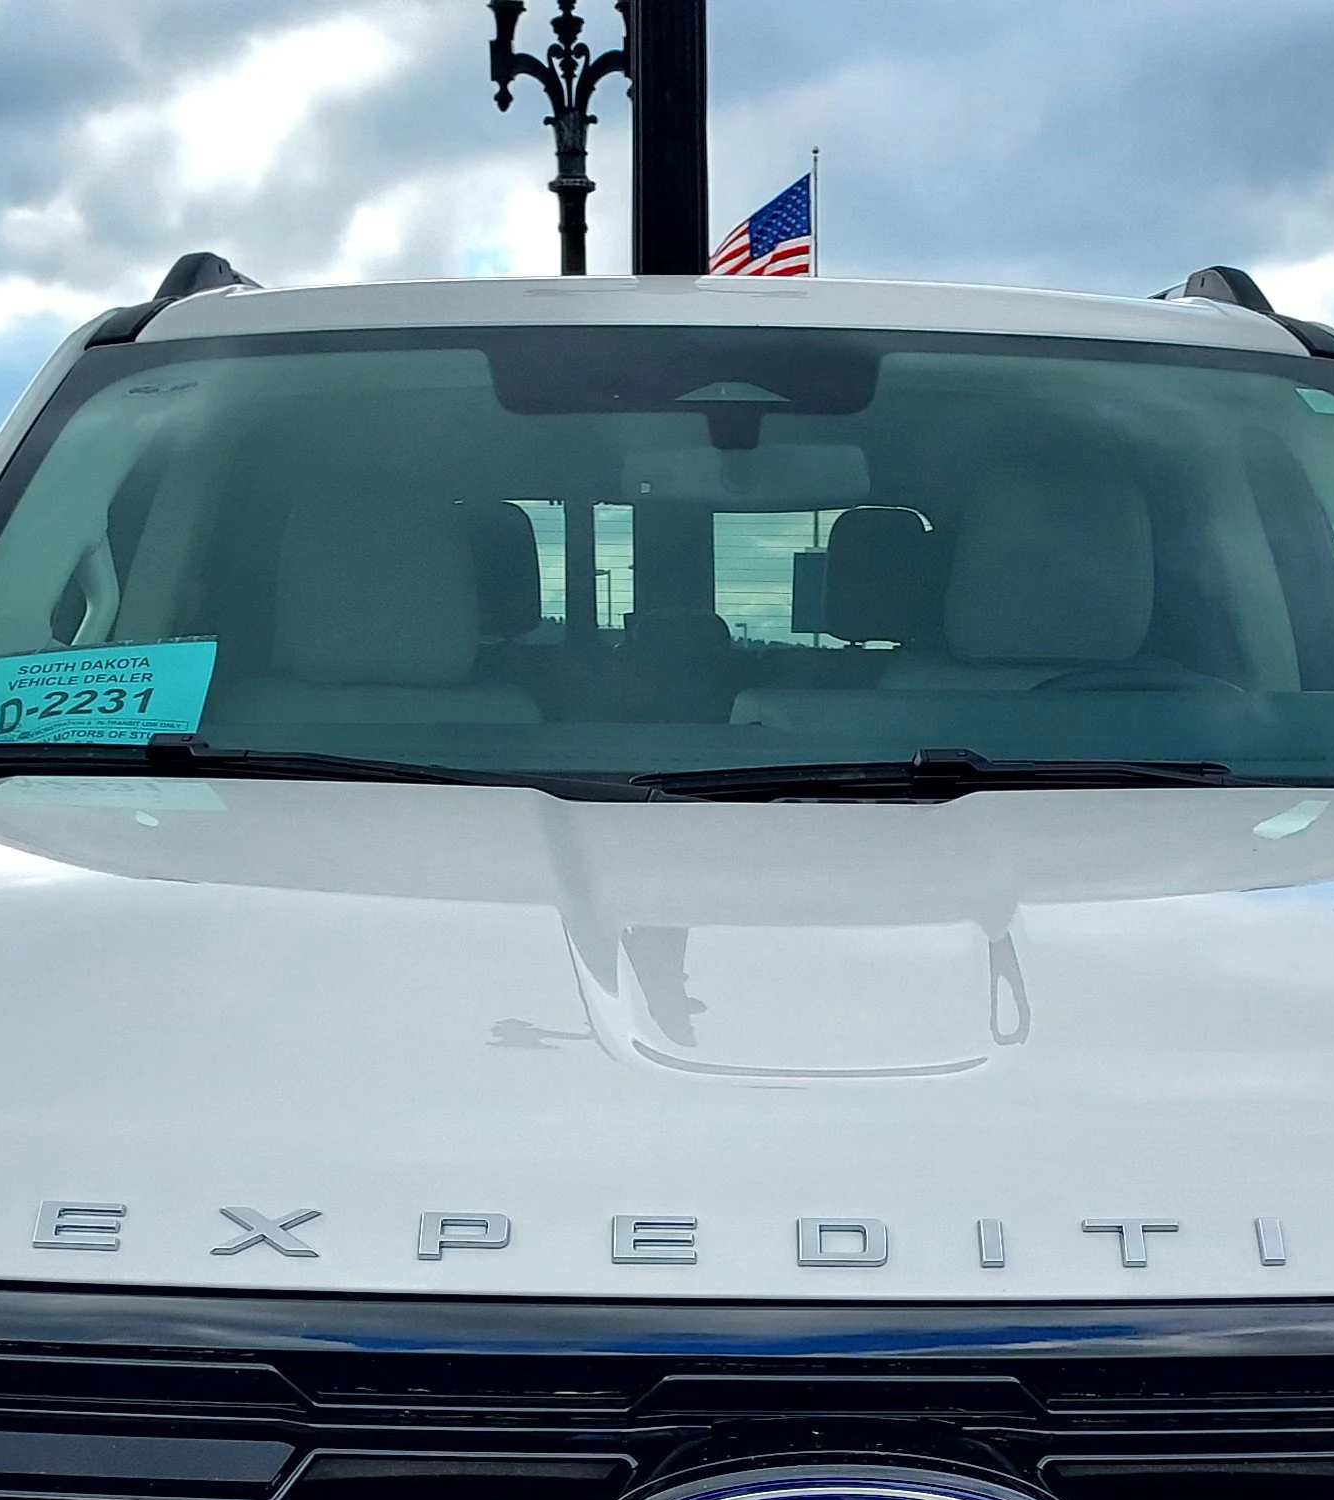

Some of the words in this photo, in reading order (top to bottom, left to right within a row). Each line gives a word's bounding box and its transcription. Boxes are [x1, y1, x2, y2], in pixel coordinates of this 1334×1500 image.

[17, 661, 77, 675] SOUTH
[80, 656, 150, 672] DAKOTA
[8, 676, 79, 691] VEHICLE
[83, 672, 153, 684] DEALER
[108, 730, 125, 739] OF
